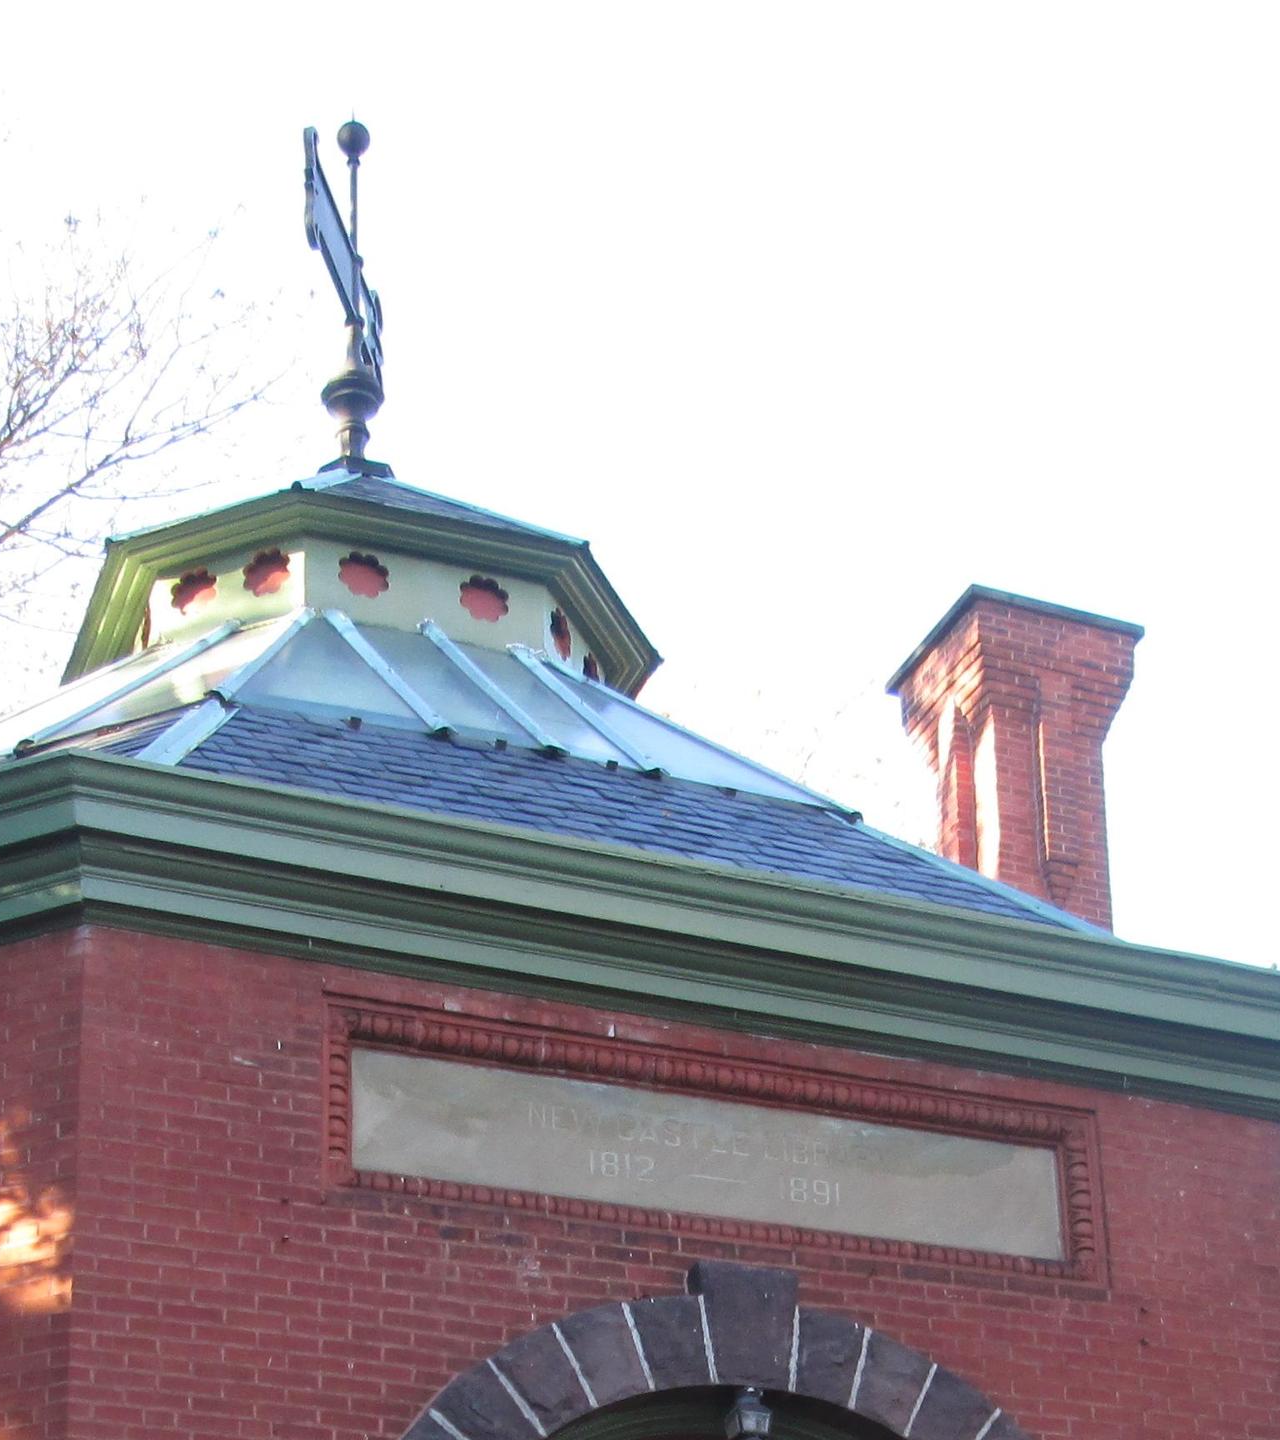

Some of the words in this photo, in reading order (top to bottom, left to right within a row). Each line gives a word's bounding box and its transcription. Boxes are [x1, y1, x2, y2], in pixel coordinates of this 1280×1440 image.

[527, 1100, 603, 1138] NEW
[617, 1112, 751, 1157] CASTLE
[763, 1132, 882, 1172] LIBR
[588, 1149, 656, 1183] 1812
[779, 1176, 841, 1207] 1891
